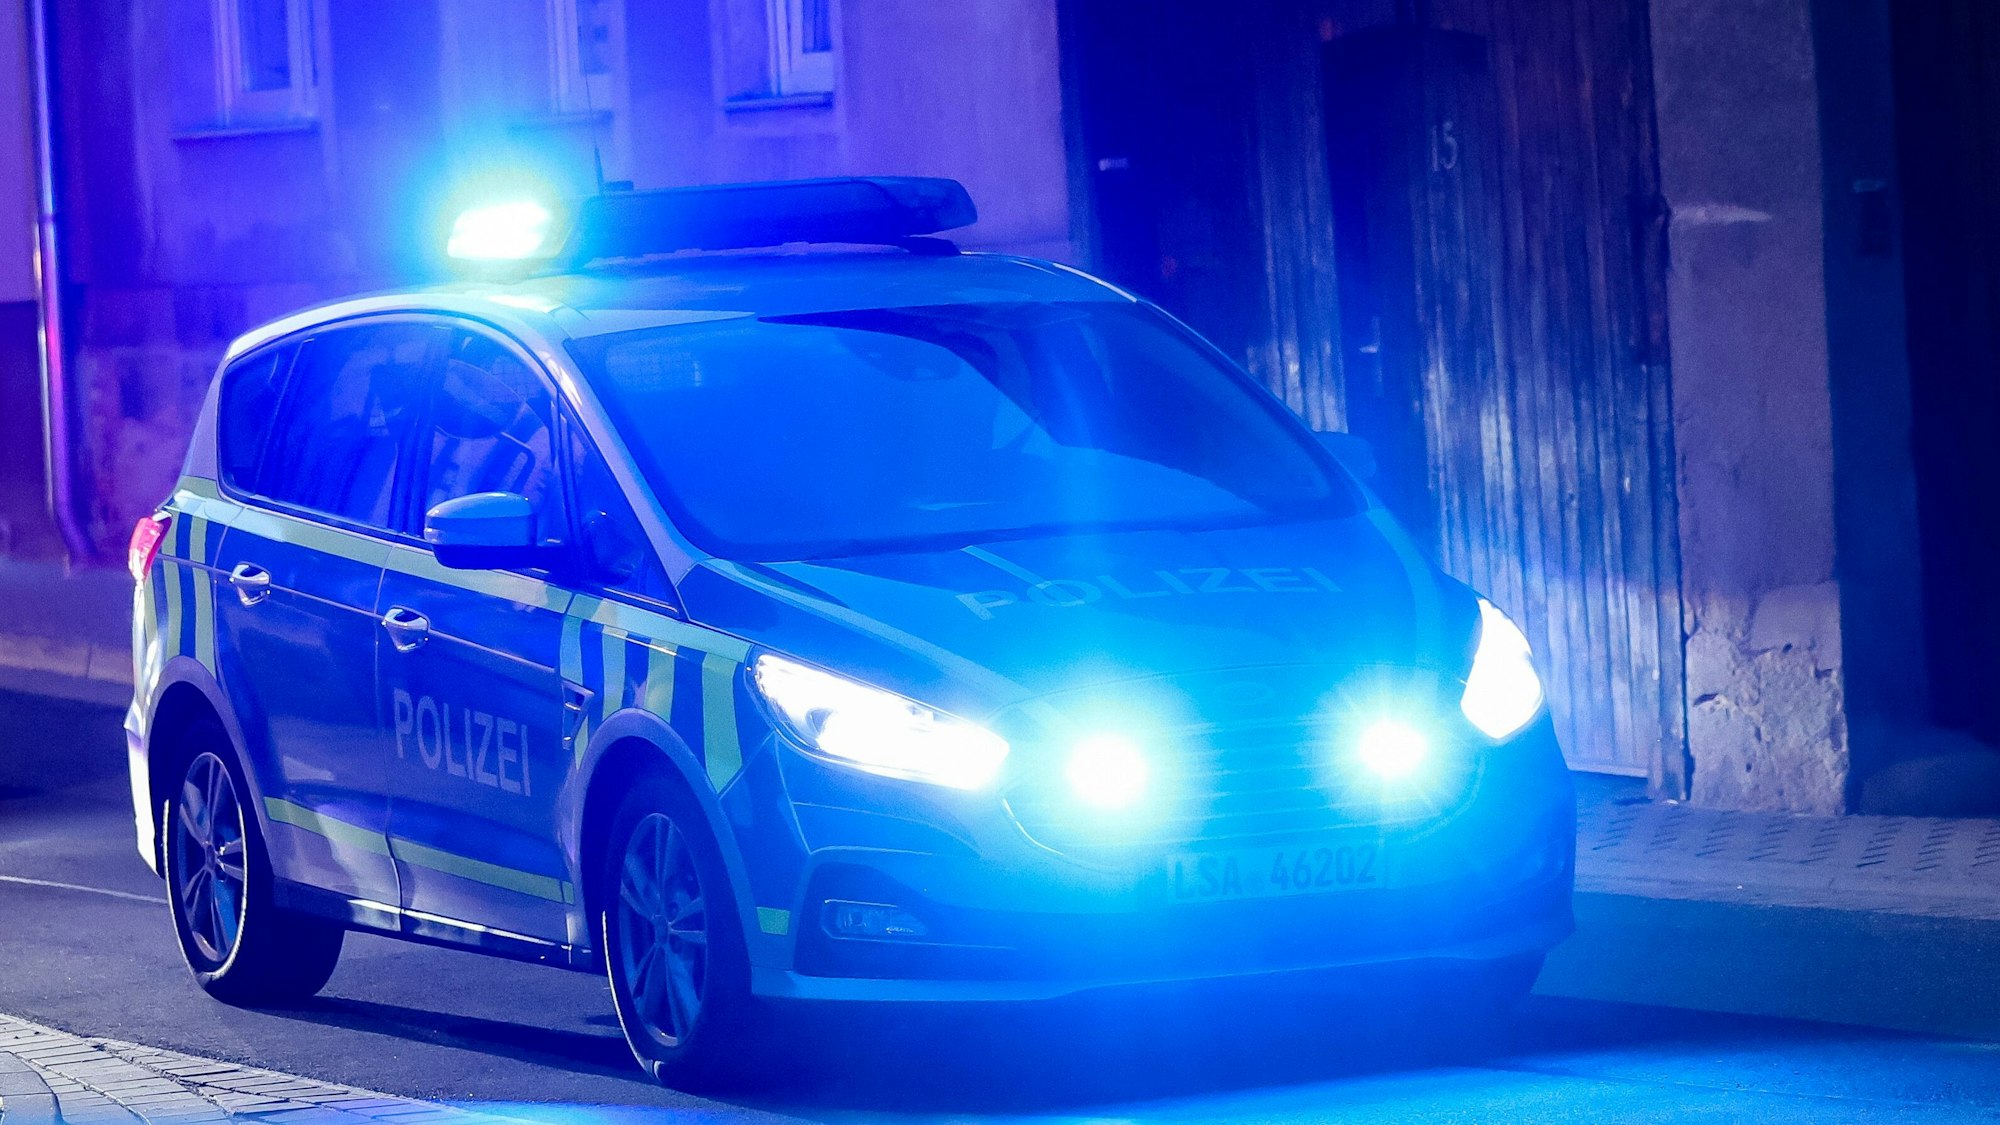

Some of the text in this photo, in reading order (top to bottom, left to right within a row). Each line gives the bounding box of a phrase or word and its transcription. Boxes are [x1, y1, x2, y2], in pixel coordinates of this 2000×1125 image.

[1431, 121, 1458, 171] 15
[956, 567, 1342, 620] POLIZEI
[393, 687, 531, 797] POLIZEI
[1174, 845, 1377, 898] LSA 46202
